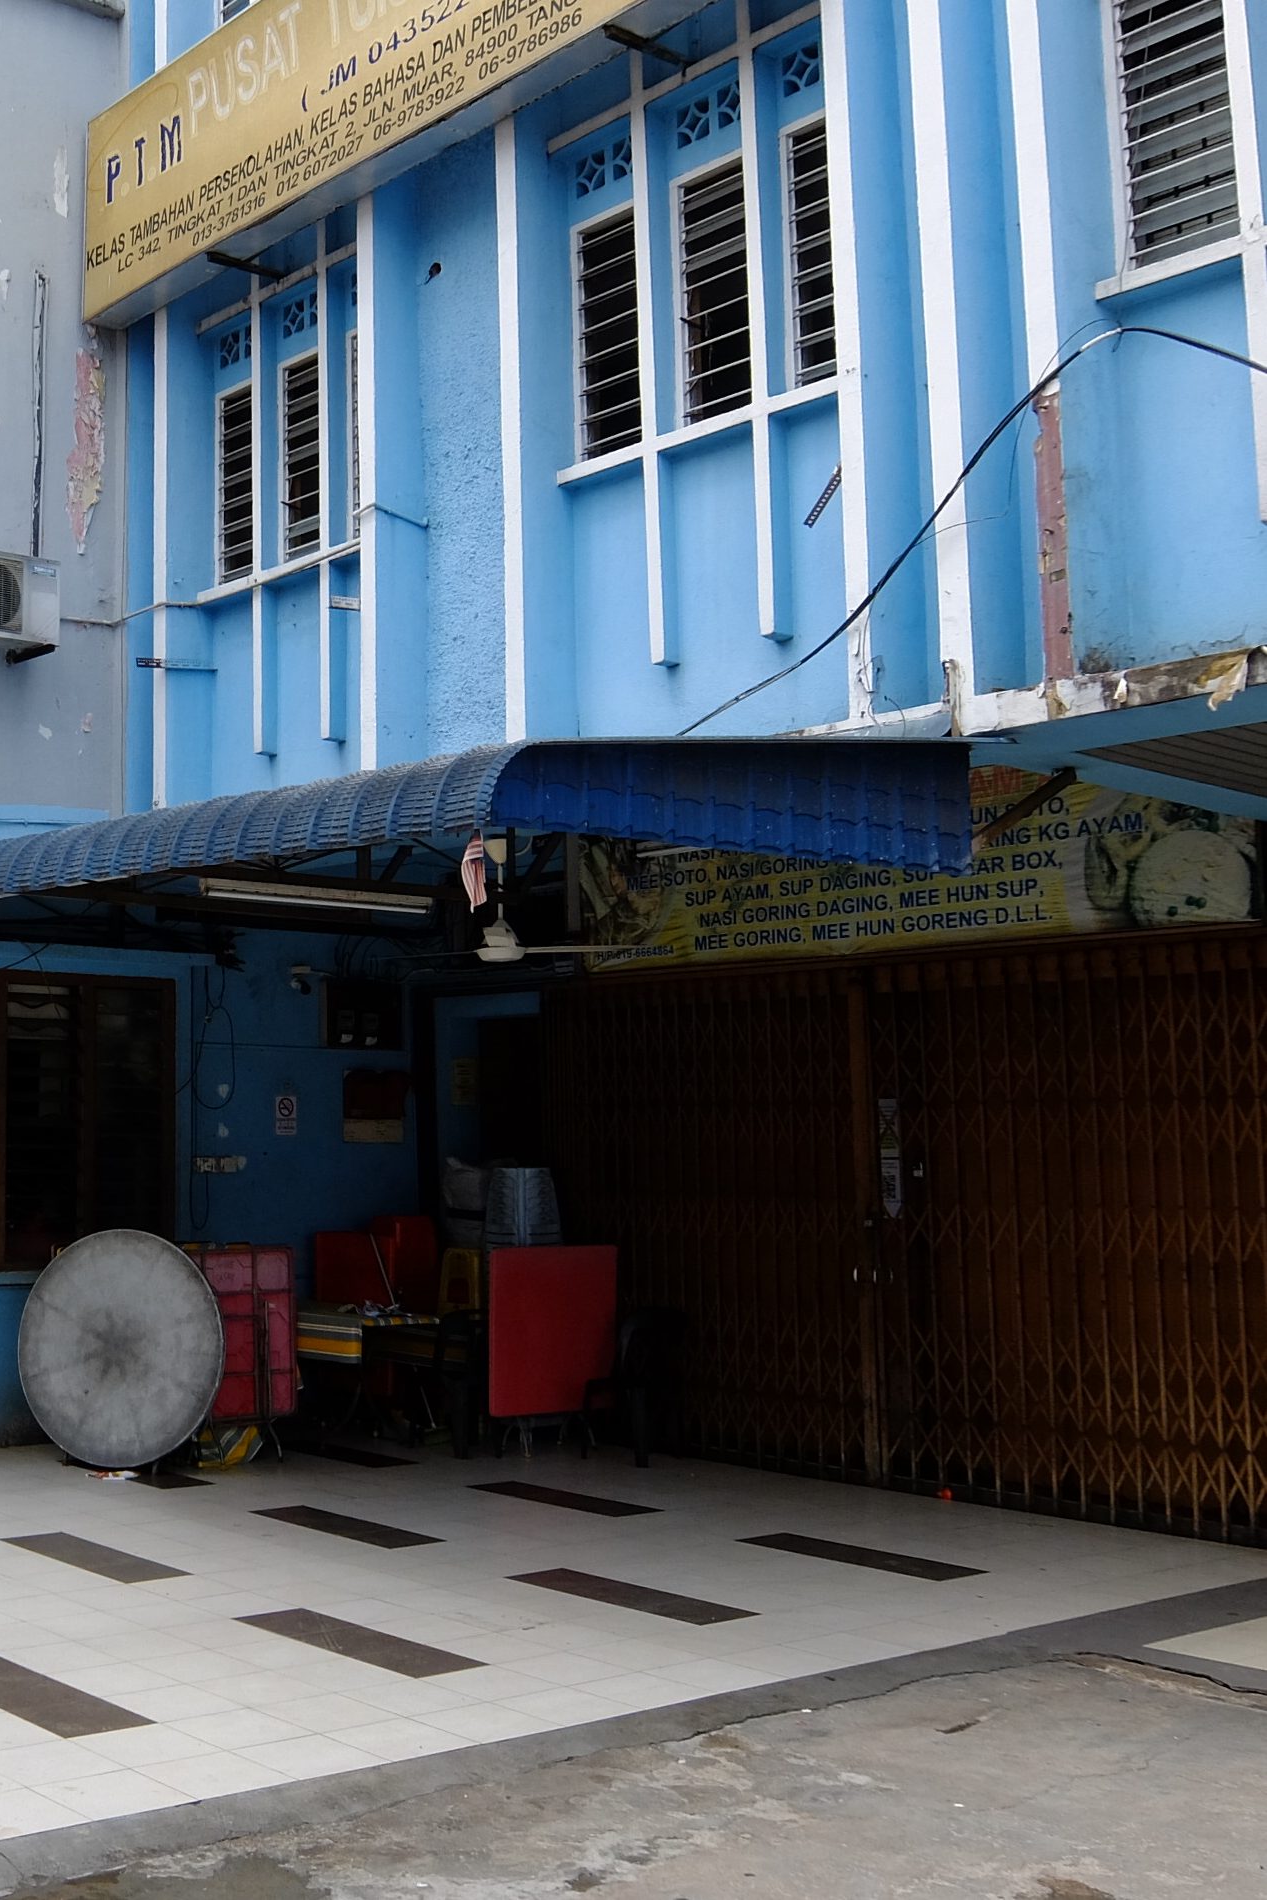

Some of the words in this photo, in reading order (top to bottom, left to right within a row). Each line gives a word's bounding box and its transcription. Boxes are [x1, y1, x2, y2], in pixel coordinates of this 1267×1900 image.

[86, 234, 125, 271] KELAS
[129, 190, 194, 246] TAMBAHAN
[199, 124, 305, 207] PERSEKOLAHAN,
[309, 92, 357, 139] KELAS
[363, 51, 426, 107] BAHASA
[432, 24, 467, 65] DAN
[472, 0, 537, 42] PEMB
[117, 252, 134, 273] LC
[167, 199, 224, 244] TINGKAT
[237, 172, 268, 200] DAN
[274, 128, 339, 179] TINGKAT
[363, 98, 396, 127] JLN.
[402, 62, 457, 106] MUAR,
[465, 24, 518, 66] 84900
[192, 192, 266, 247] 013-3781316
[276, 176, 300, 198] 012
[303, 135, 364, 181] 6072027
[373, 76, 466, 141] 06-9783922
[478, 7, 582, 80] 06-9786986
[1039, 822, 1070, 841] KG
[1077, 812, 1149, 836] AYAM,
[627, 874, 659, 891] MEE
[664, 868, 711, 888] SOTO,
[716, 862, 754, 881] NASI
[760, 857, 829, 876] GORING
[685, 889, 717, 907] SUP
[722, 883, 774, 904] AYAM,
[779, 879, 814, 897] SUP
[820, 869, 897, 893] DAGING,
[1012, 850, 1062, 871] BOX,
[694, 934, 729, 951] MEE
[734, 926, 806, 947] GORING,
[813, 922, 849, 940] MEE
[856, 918, 894, 936] HUN
[902, 909, 989, 932] GORENG
[996, 904, 1053, 922] D.L.L.
[700, 910, 737, 928] NASI
[742, 903, 810, 924] GORING
[817, 895, 893, 918] DAGING,
[899, 889, 941, 908] MEE
[947, 884, 989, 903] HUN
[996, 878, 1044, 898] SUP,
